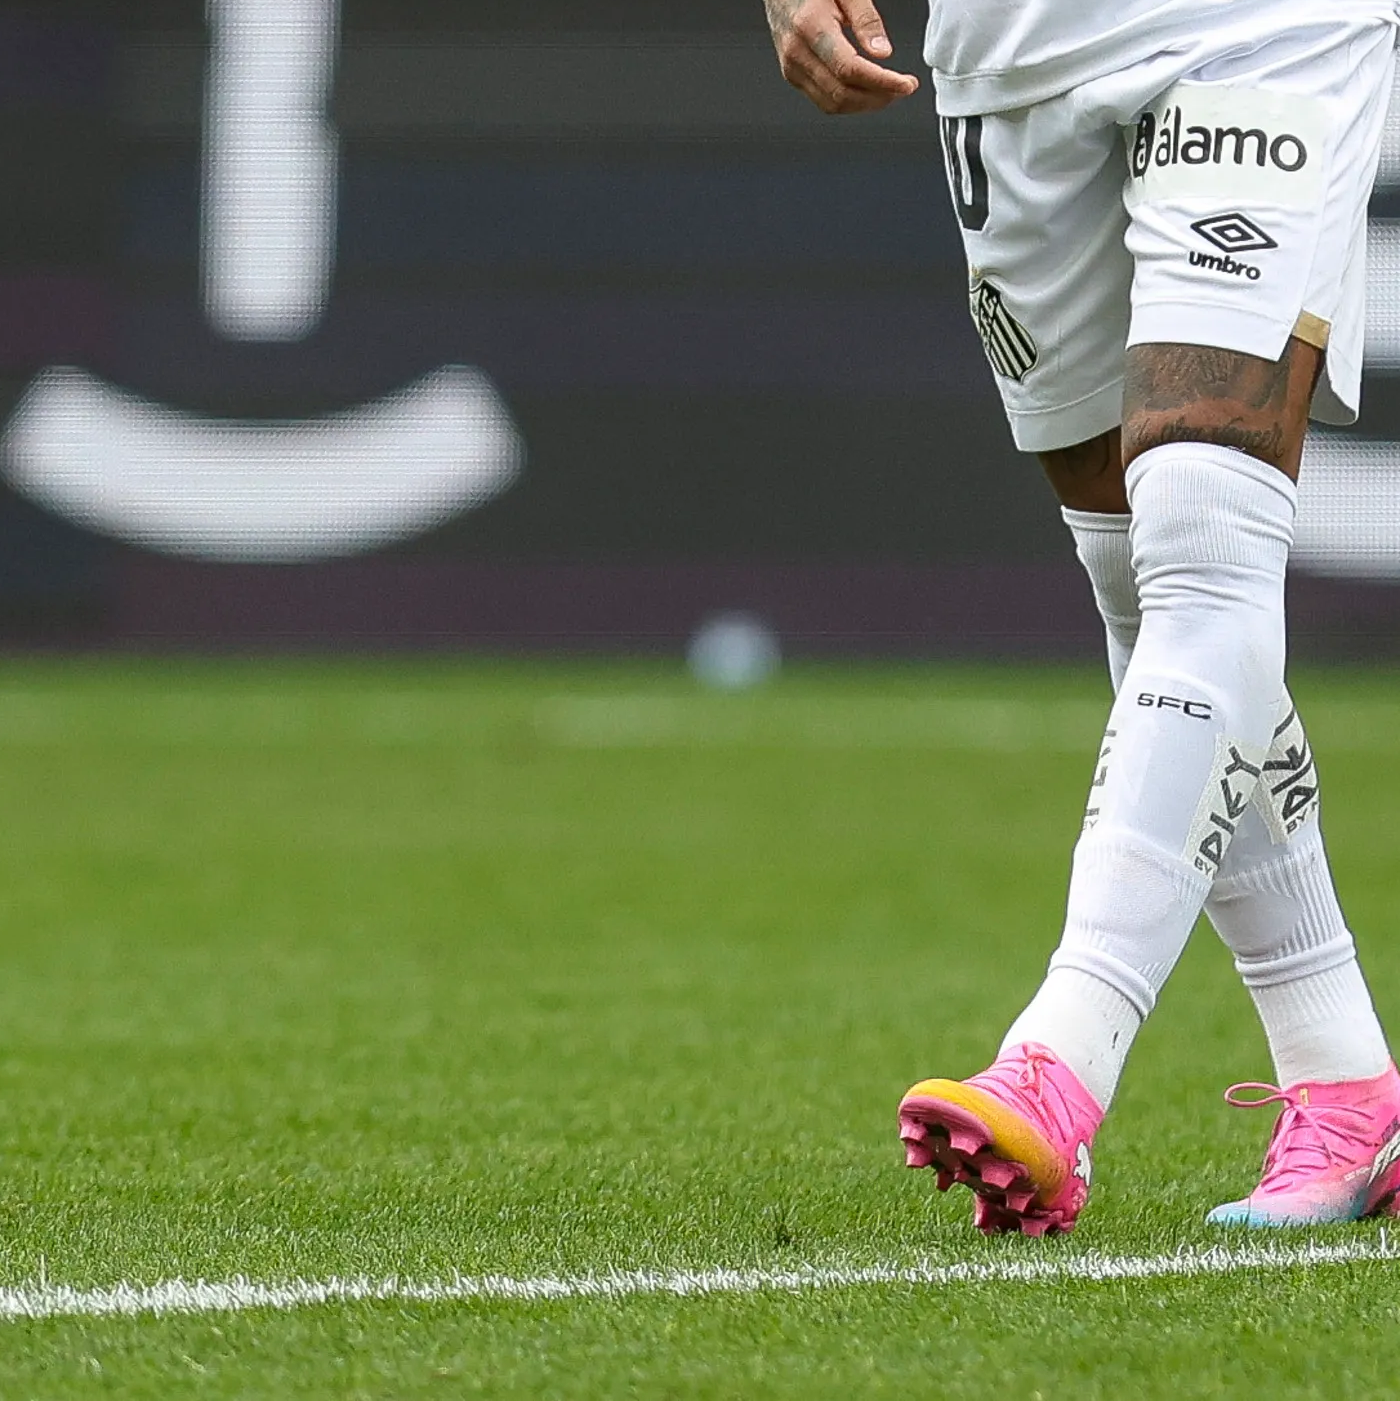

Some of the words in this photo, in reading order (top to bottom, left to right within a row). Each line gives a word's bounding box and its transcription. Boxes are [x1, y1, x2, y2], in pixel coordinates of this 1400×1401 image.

[1155, 105, 1307, 172] álamo
[1189, 251, 1261, 280] umbro
[1137, 692, 1212, 720] SFC
